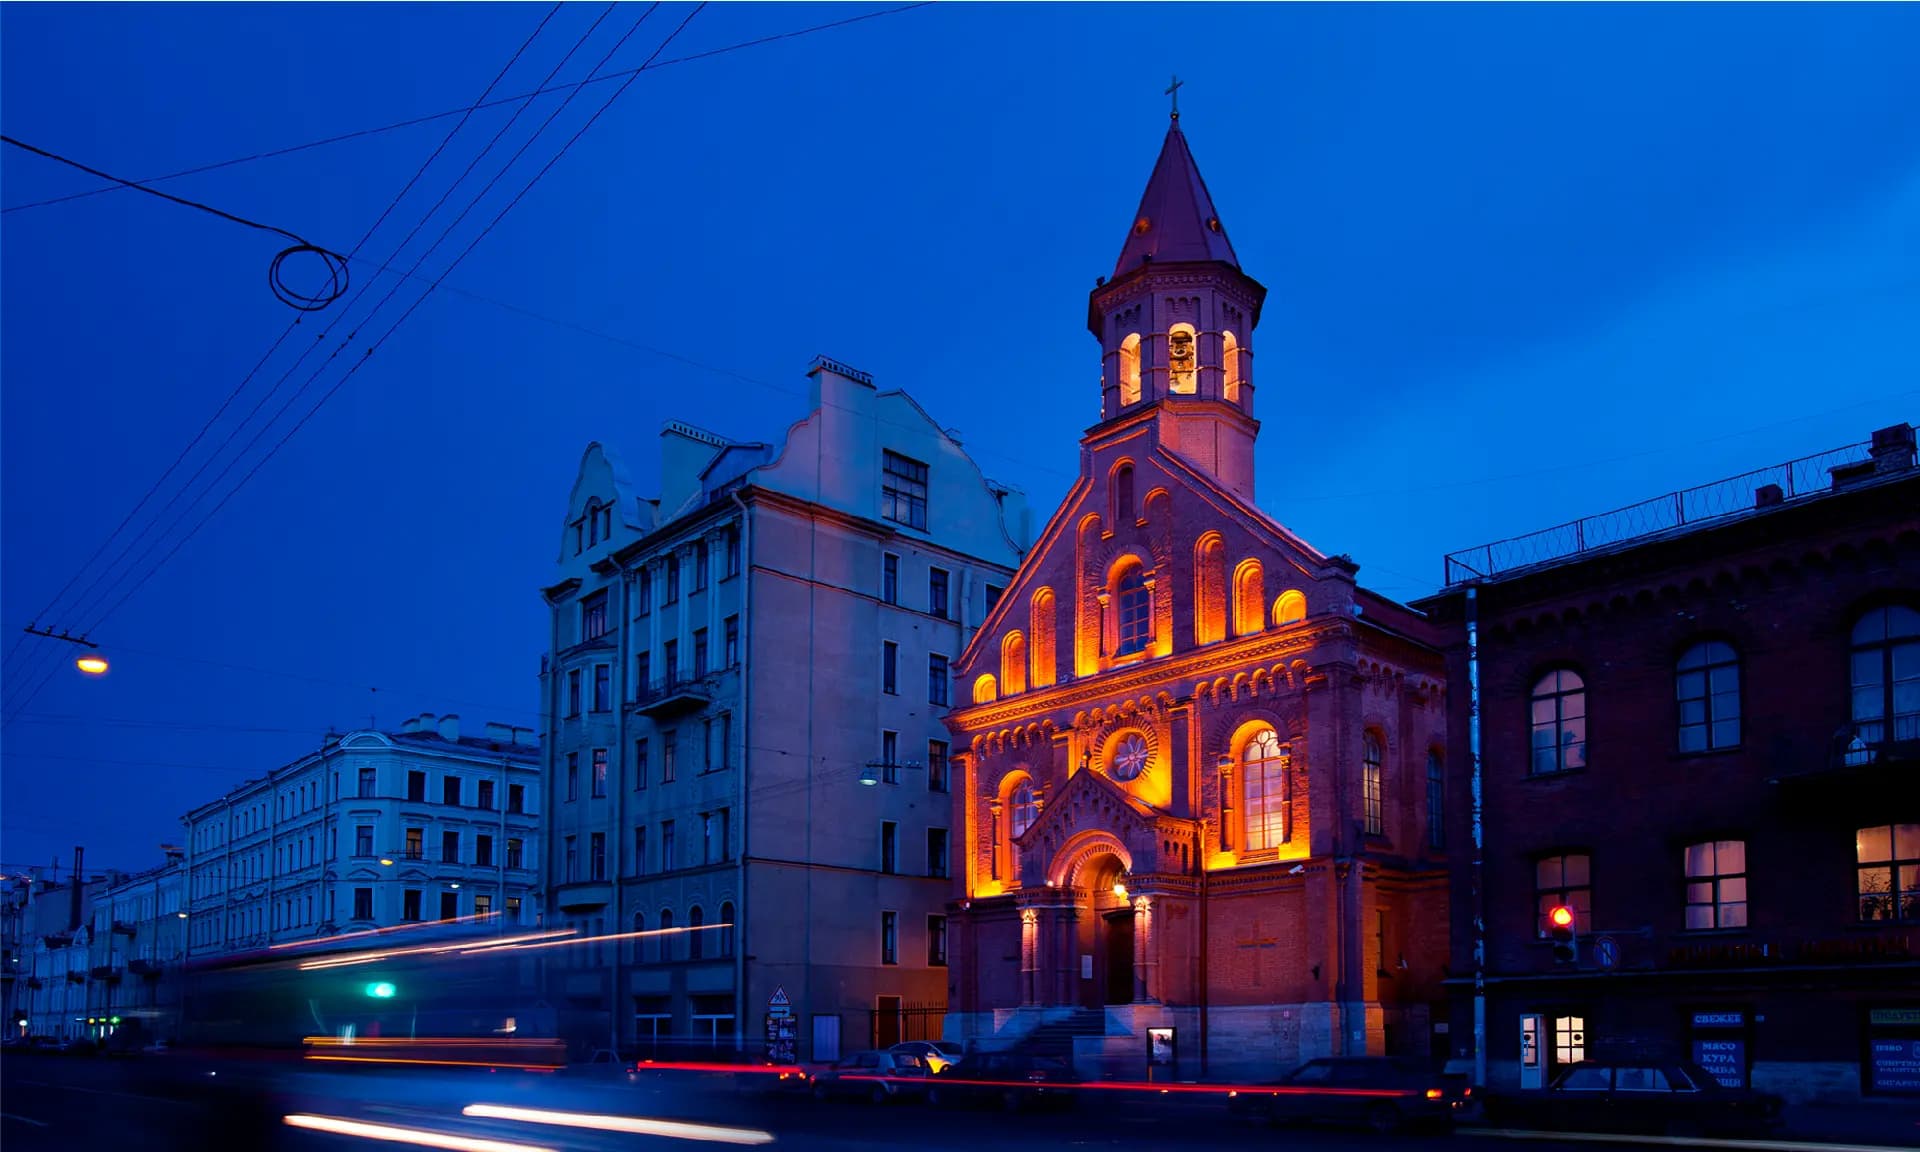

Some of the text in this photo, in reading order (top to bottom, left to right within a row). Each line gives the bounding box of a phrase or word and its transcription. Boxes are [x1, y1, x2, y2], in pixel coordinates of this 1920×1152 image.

[1695, 1014, 1742, 1024] СВЕЖЕЕ
[1702, 1042, 1736, 1051] МЯСО
[1876, 1044, 1903, 1052] ПИВО
[1702, 1053, 1736, 1063] КУРА
